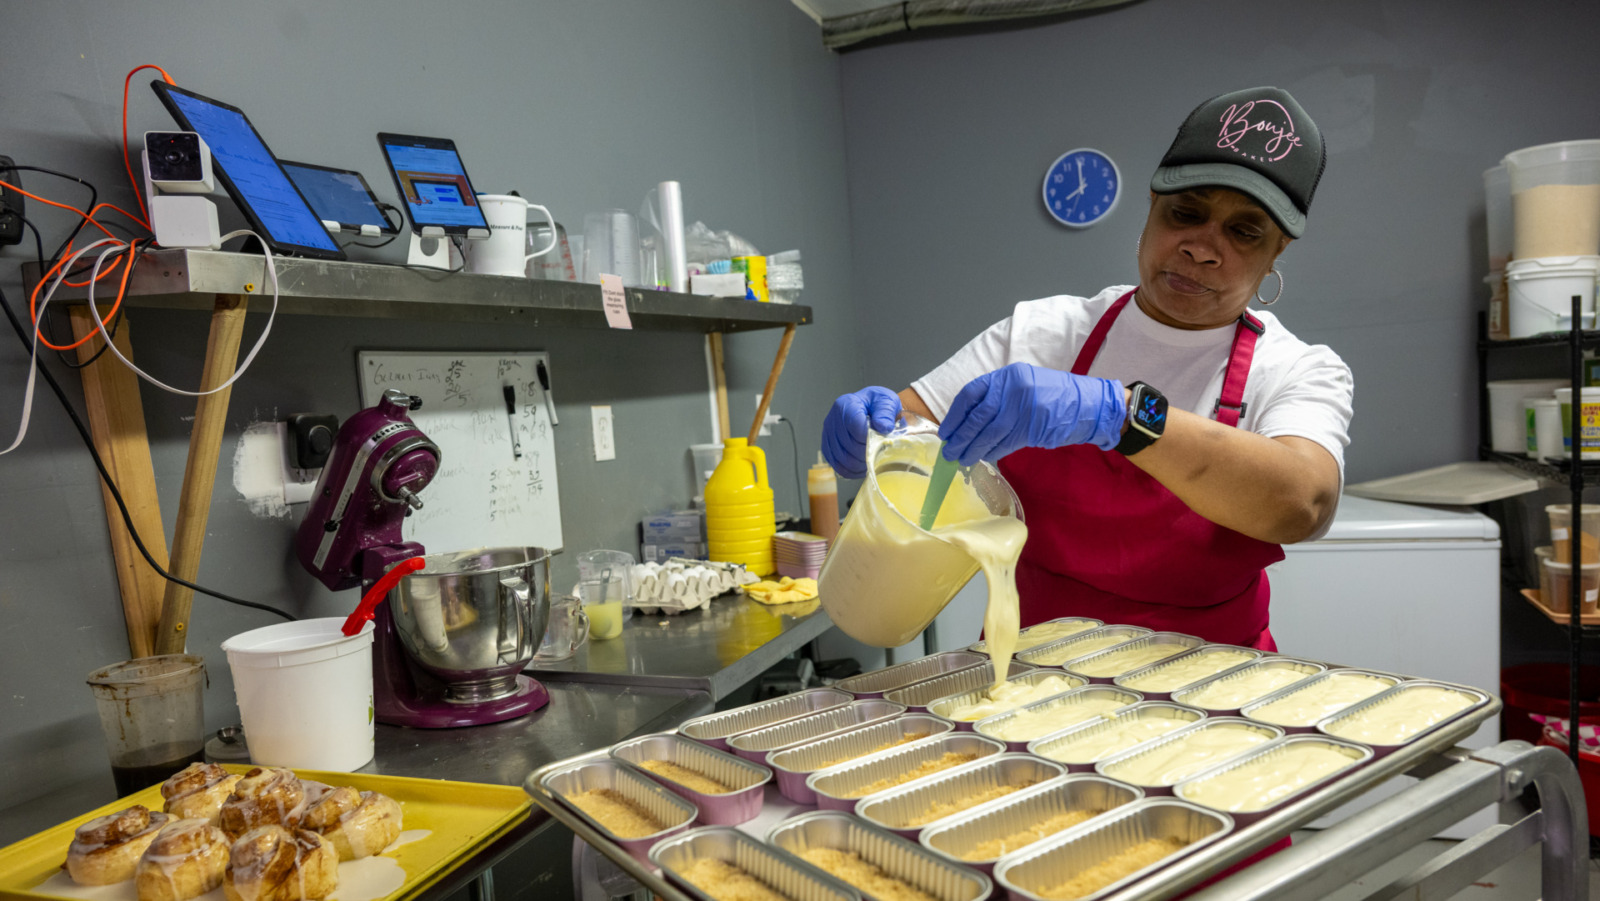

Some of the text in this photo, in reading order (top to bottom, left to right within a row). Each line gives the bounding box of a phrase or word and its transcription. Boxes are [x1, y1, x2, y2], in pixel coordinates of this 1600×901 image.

[1217, 101, 1303, 153] Boujee
[1063, 162, 1072, 172] 11
[1102, 167, 1109, 177] 2
[1054, 173, 1064, 183] 10
[1107, 180, 1114, 190] 3
[1093, 205, 1100, 215] 5
